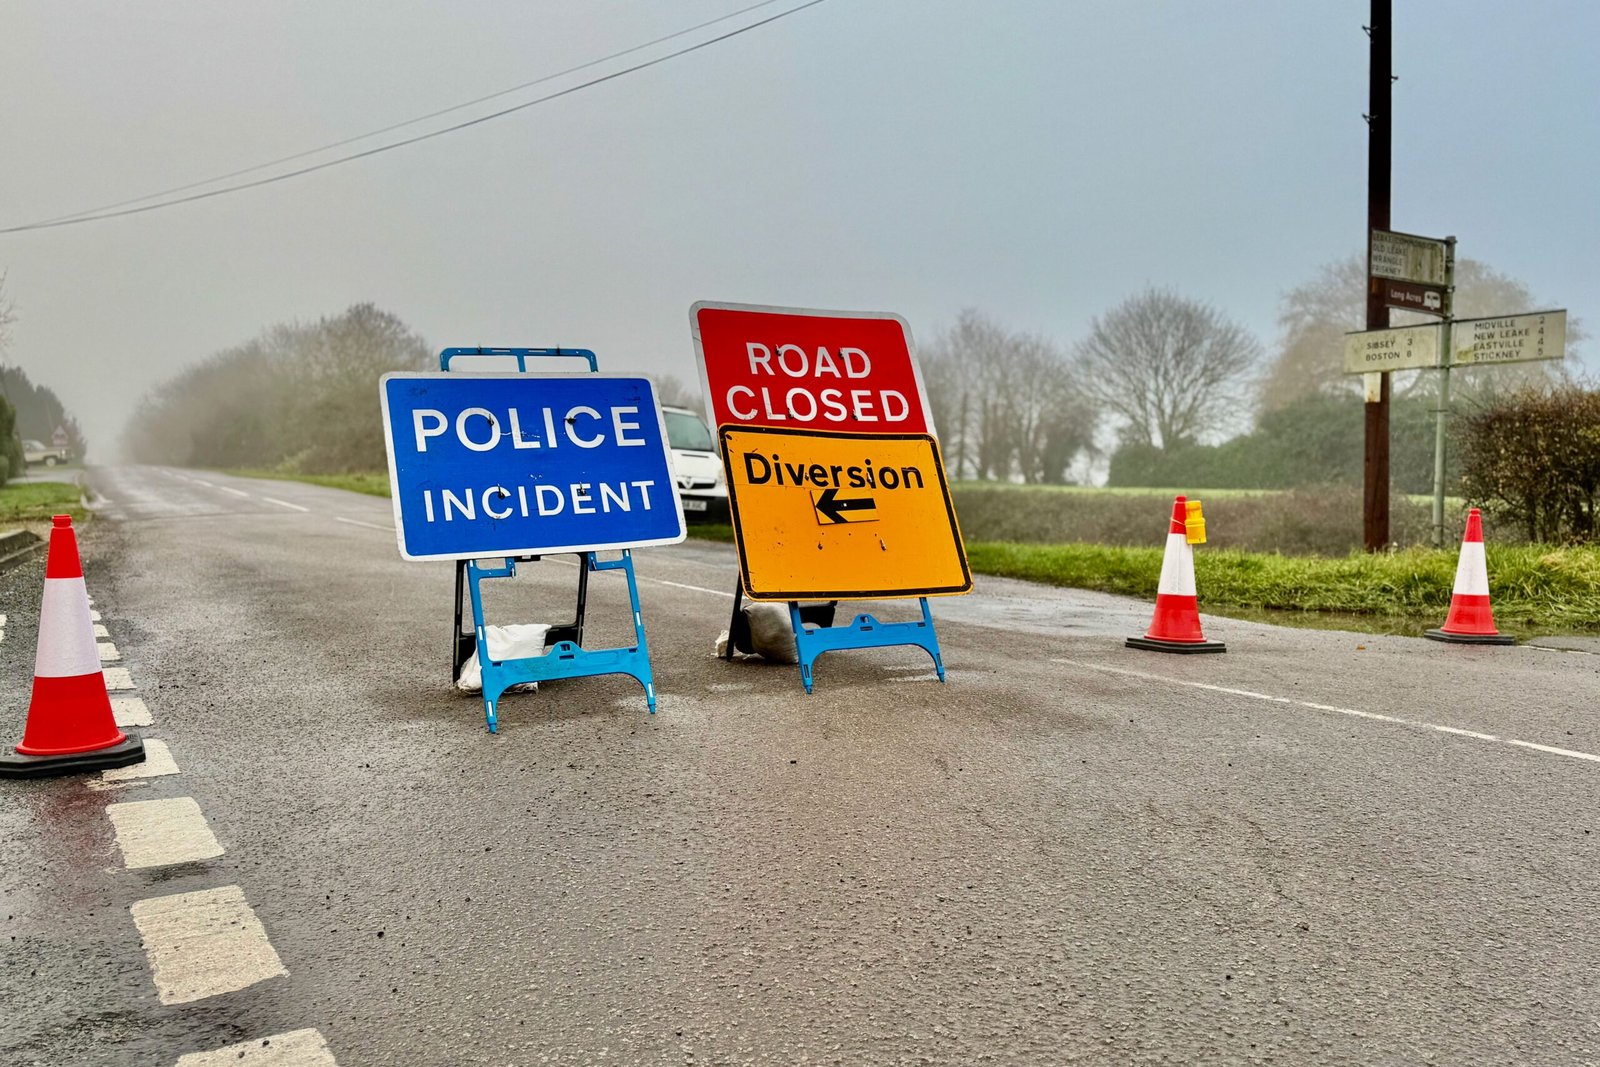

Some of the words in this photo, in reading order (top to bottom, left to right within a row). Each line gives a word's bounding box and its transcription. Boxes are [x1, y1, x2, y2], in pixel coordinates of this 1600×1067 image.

[1373, 242, 1386, 253] OLD
[1387, 244, 1408, 257] LEAKE
[1373, 254, 1402, 267] WRANGLE
[1372, 264, 1402, 276] FRISKNEY
[1391, 289, 1405, 302] Long
[1406, 291, 1422, 303] Acres
[1474, 320, 1515, 330] MIDVILLE
[1539, 316, 1545, 324] 2
[1474, 331, 1495, 341] NEW
[1500, 328, 1530, 338] LEAKE
[1538, 327, 1544, 335] 4
[1367, 338, 1396, 350] SIBSEY
[1407, 338, 1413, 346] 3
[1473, 339, 1524, 351] EASTVILLE
[1537, 337, 1544, 345] 4
[746, 342, 871, 379] ROAD
[1366, 351, 1400, 361] BOSTON
[1473, 350, 1520, 361] STICKNEY
[726, 385, 909, 422] CLOSED
[412, 405, 646, 453] POLICE
[743, 452, 924, 490] Diversion
[423, 480, 655, 523] INCIDENT
